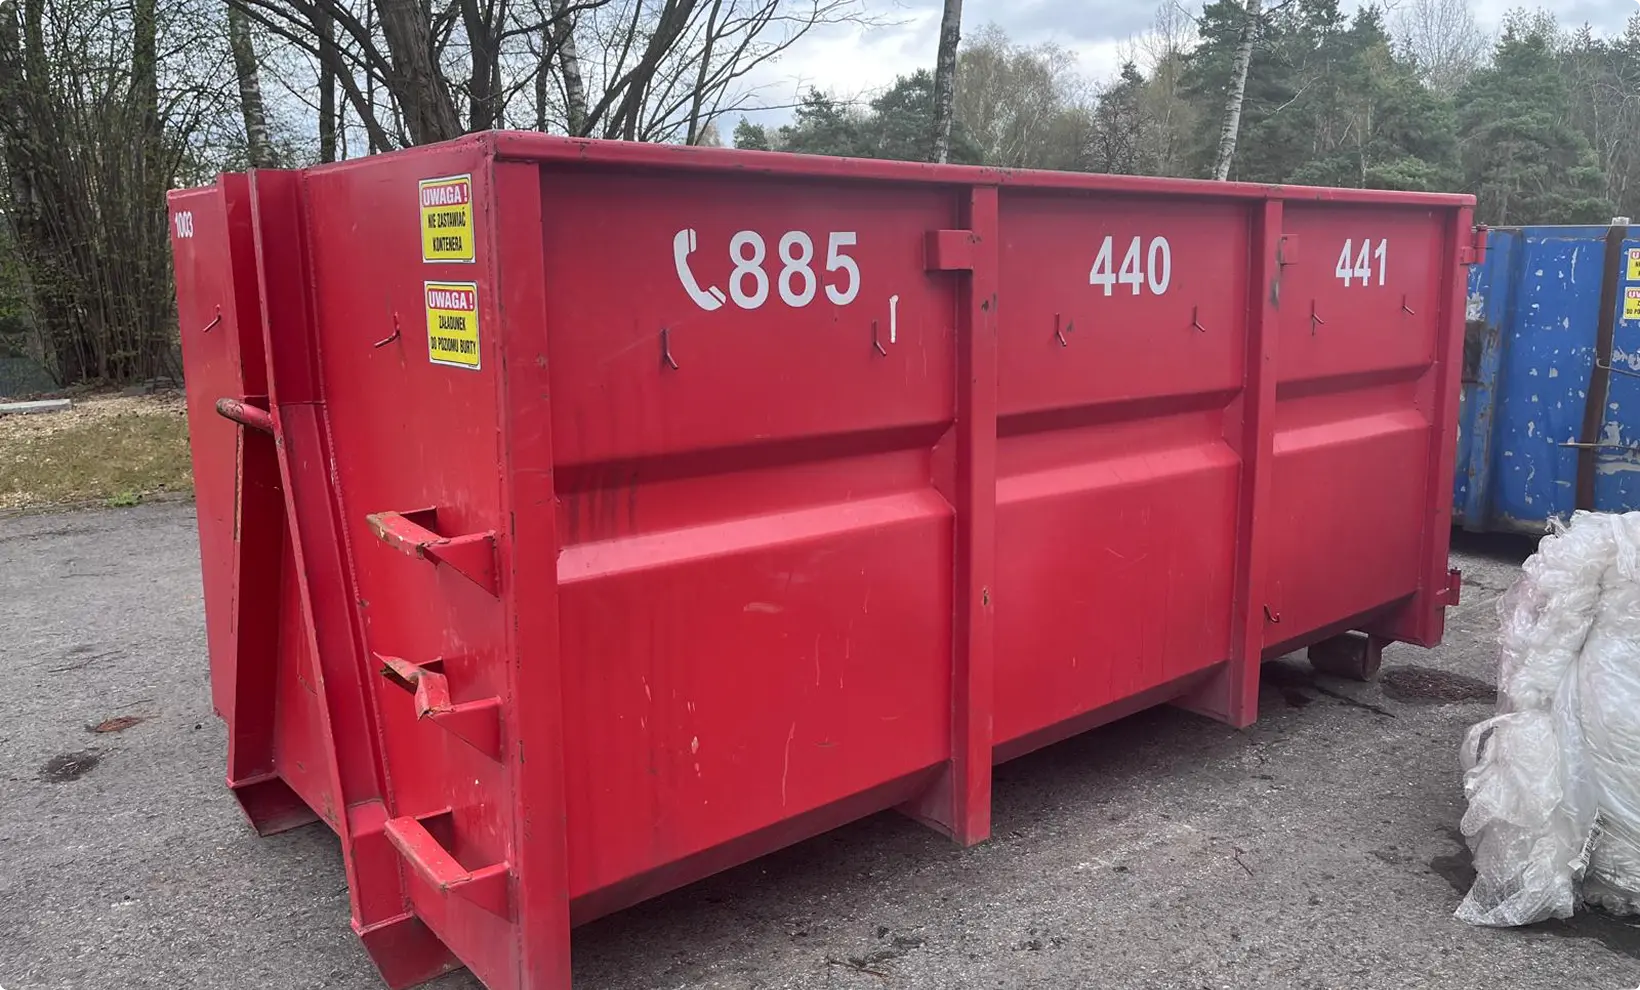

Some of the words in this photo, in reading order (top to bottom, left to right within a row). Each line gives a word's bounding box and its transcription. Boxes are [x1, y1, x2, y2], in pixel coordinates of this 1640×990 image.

[174, 211, 194, 238] 1003
[428, 213, 436, 228] NIE
[437, 207, 466, 228] ZASTAWIAĆ
[432, 236, 463, 252] KONTENERA
[729, 230, 861, 310] 885
[1089, 236, 1171, 296] 440
[1335, 238, 1387, 287] 441
[438, 315, 466, 331] ZAŁADUNEK
[430, 336, 437, 350] DO
[438, 337, 459, 352] POZIOMU
[460, 339, 476, 355] BURTY
